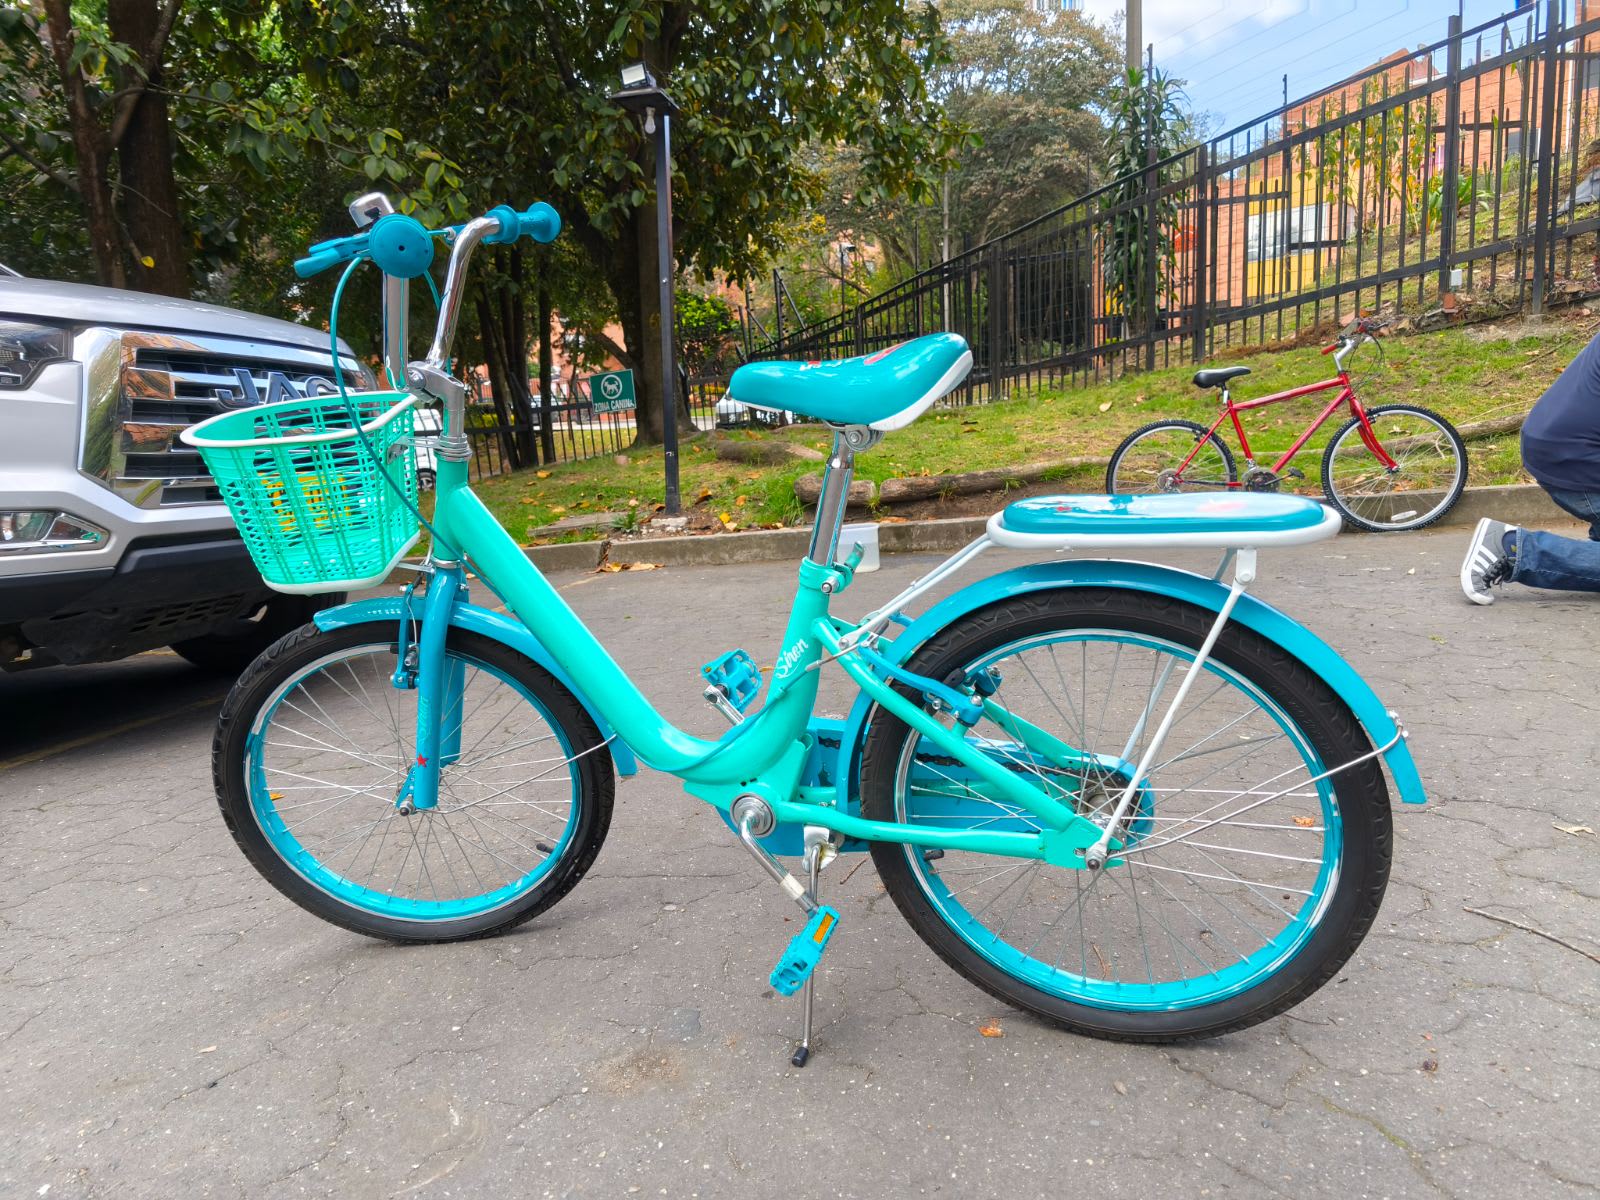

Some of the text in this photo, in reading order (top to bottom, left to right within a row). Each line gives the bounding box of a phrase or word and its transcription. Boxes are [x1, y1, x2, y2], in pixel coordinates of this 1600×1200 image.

[594, 399, 635, 412] ZONA CANINA
[775, 638, 809, 678] Siren
